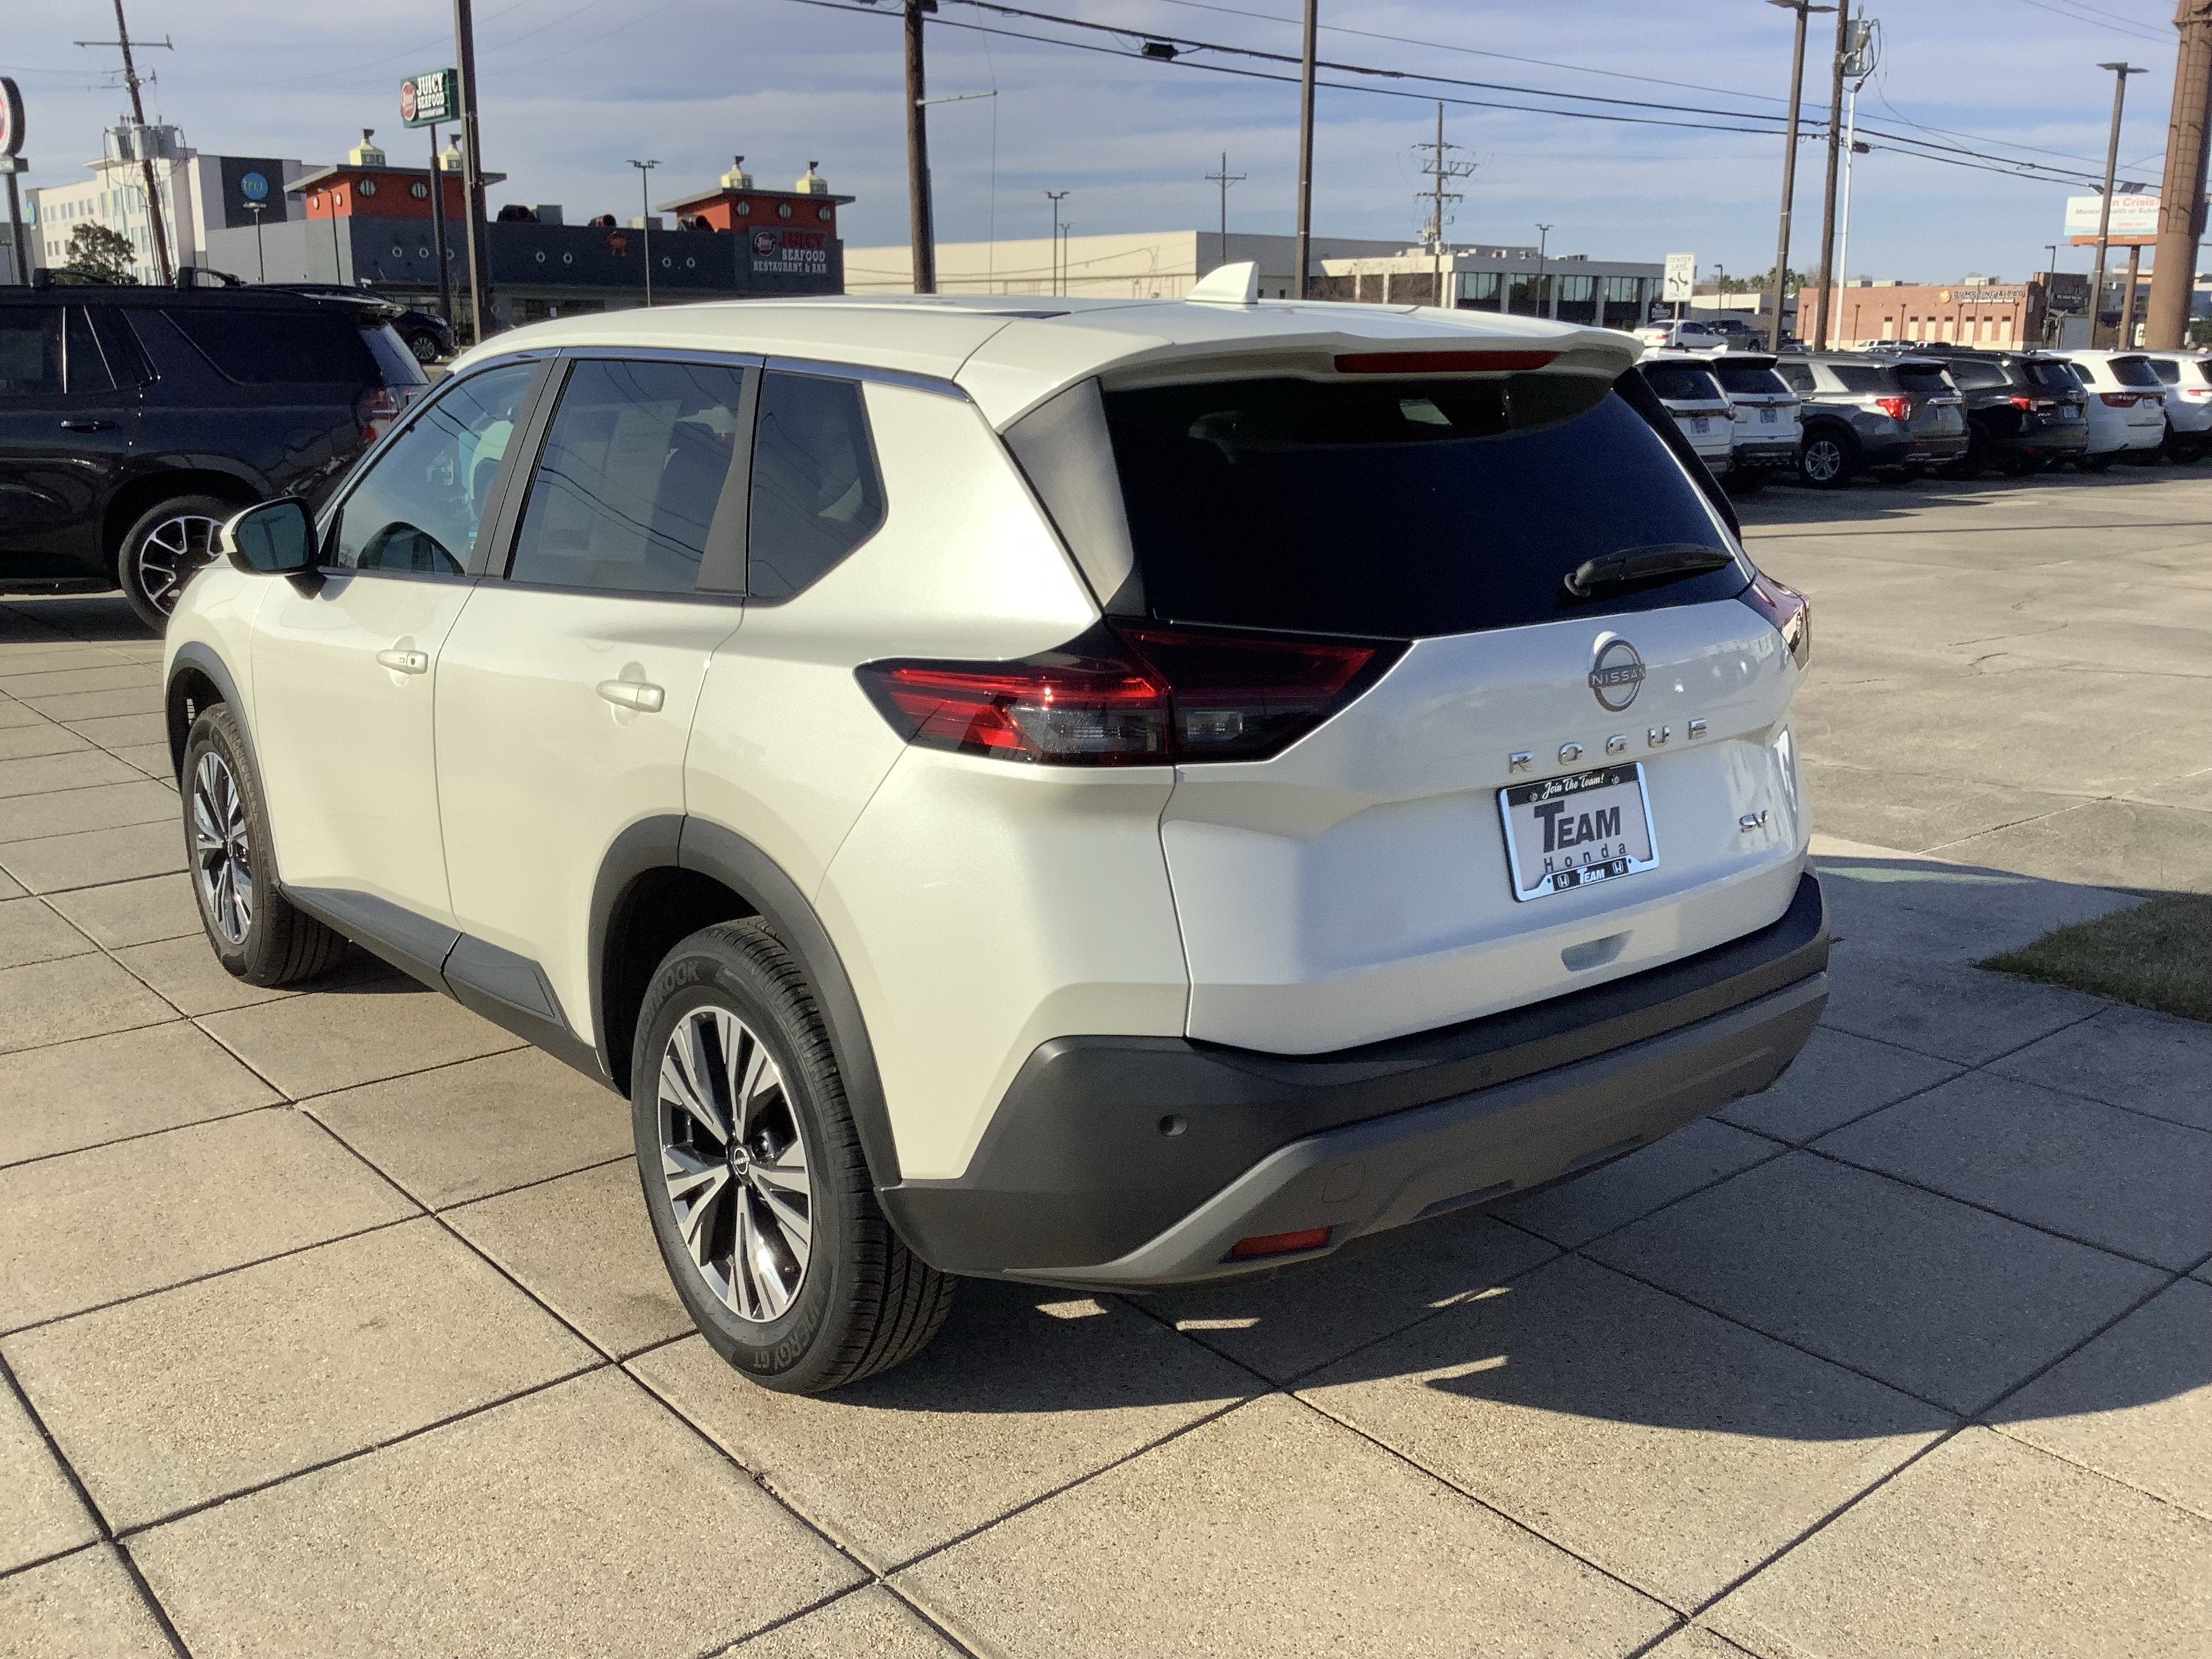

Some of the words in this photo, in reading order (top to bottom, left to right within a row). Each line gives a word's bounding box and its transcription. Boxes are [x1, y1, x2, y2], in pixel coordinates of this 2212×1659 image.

[416, 72, 443, 96] JUICY
[417, 91, 445, 110] SEAFOOD
[781, 247, 825, 262] SEAFOOD
[753, 260, 803, 272] RESTAURANT
[811, 263, 827, 274] BAR
[1591, 667, 1646, 685] NISSAN
[1509, 717, 1707, 775] ROGUE
[1542, 781, 1563, 800] Join
[1562, 778, 1579, 792] The
[1578, 773, 1605, 788] Team!
[1533, 800, 1622, 854] TEAM
[1739, 809, 1768, 834] SV
[1543, 842, 1626, 874] Honda
[1576, 867, 1606, 884] TEAM
[752, 1350, 771, 1369] GT
